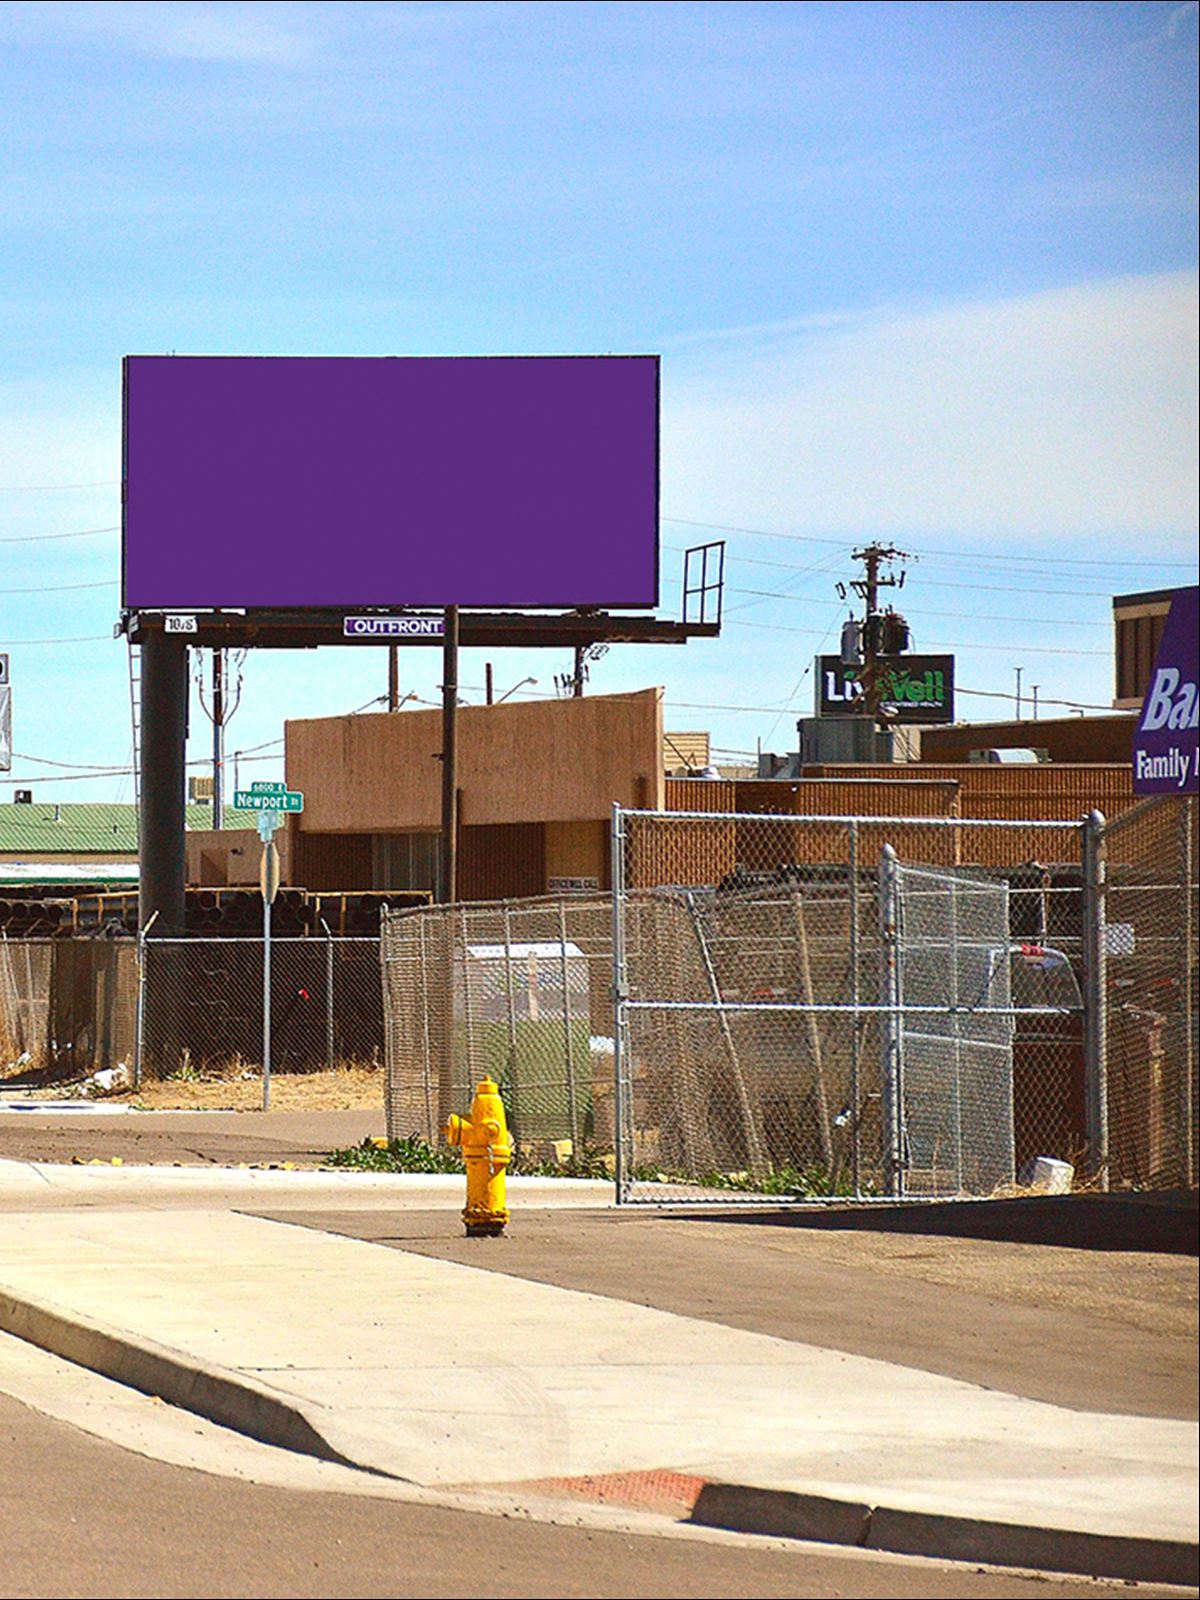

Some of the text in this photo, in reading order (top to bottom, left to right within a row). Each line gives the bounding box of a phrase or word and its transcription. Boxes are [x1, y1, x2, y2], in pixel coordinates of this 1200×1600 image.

[354, 620, 442, 633] OUTFRONT
[1136, 746, 1190, 787] Family
[237, 793, 288, 809] Newport
